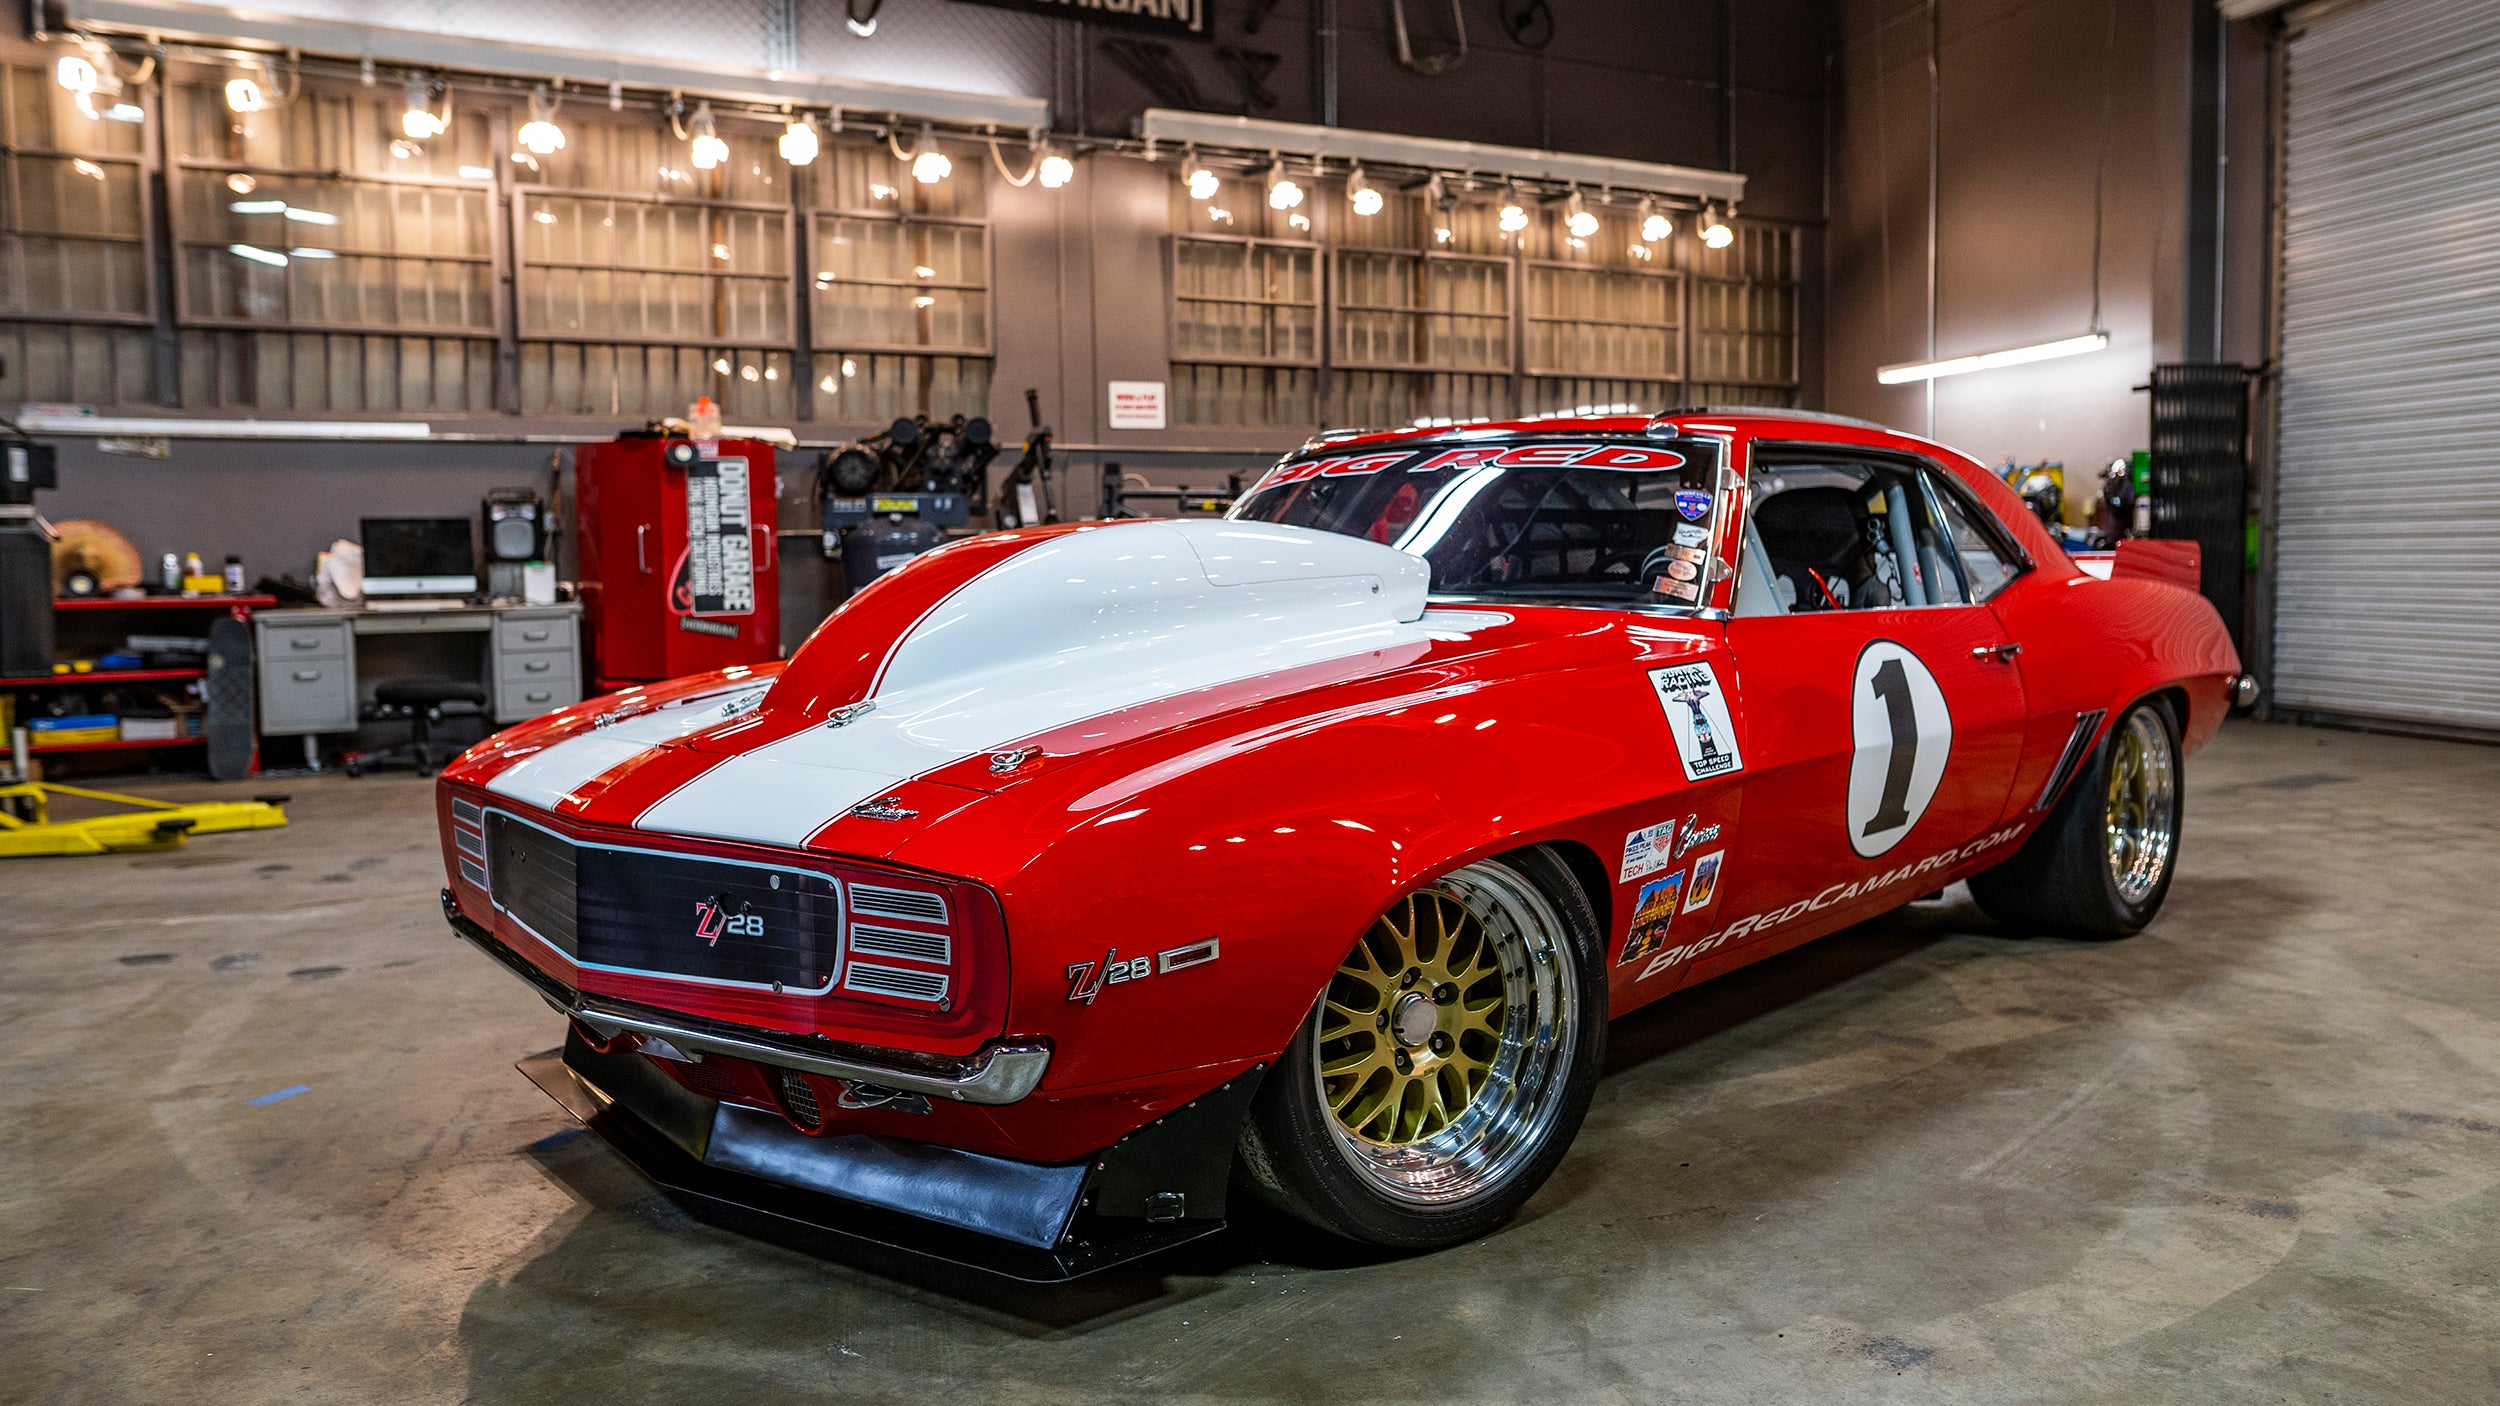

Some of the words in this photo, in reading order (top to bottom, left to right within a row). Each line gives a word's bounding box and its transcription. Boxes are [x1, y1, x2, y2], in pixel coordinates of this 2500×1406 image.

[1253, 451, 1420, 494] BIG
[1407, 444, 1686, 472] RED
[717, 462, 746, 528] DONUT
[722, 534, 751, 610] GARAGE
[1661, 672, 1711, 691] RACING
[1694, 760, 1708, 768] TOP
[1708, 755, 1730, 765] SPEED
[1696, 762, 1732, 775] CHALLENGE
[1862, 658, 1918, 838] 1
[1657, 823, 1673, 836] TAG
[1623, 863, 1644, 879] TECH
[696, 901, 764, 947] Z/28
[1068, 948, 1151, 1005] Z/28
